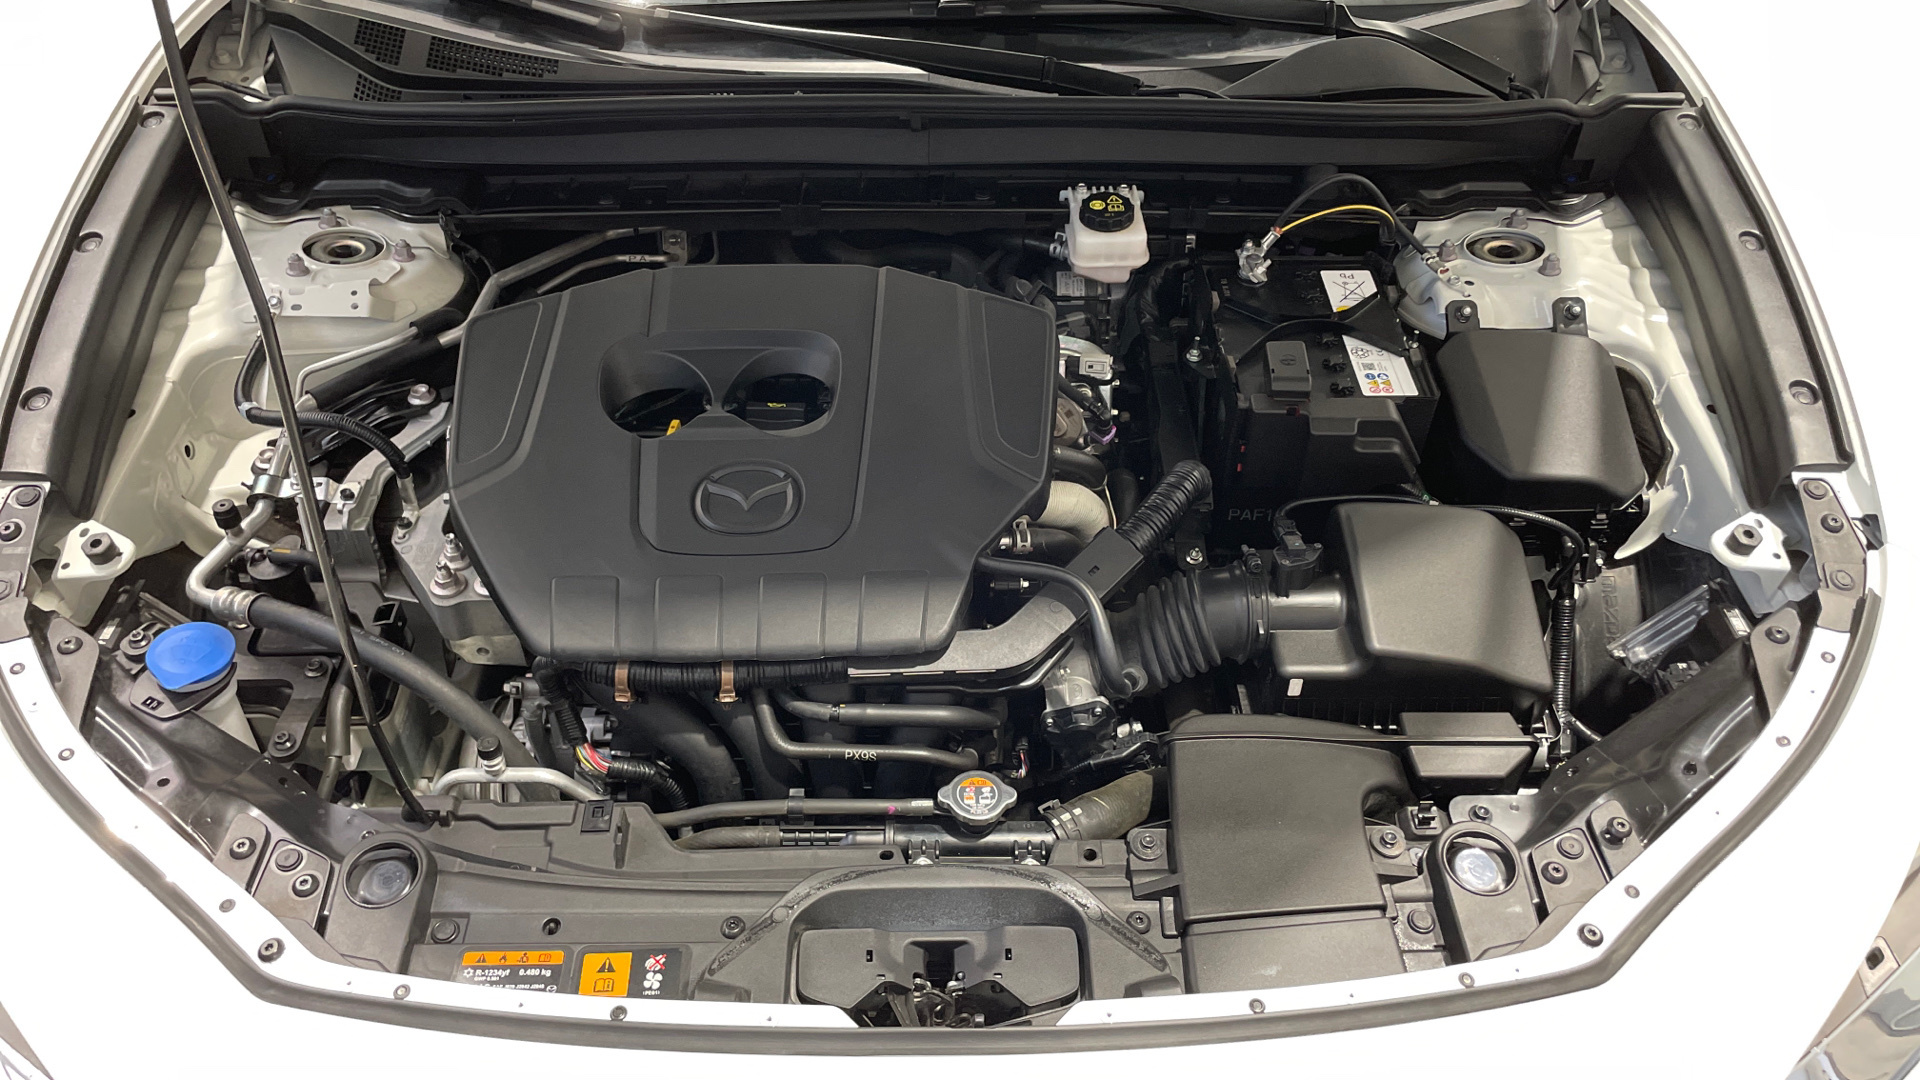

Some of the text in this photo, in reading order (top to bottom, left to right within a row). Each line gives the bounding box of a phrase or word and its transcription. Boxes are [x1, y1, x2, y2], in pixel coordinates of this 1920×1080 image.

[844, 749, 876, 762] PX9S
[475, 968, 552, 978] R-1234yf 0.480 kg
